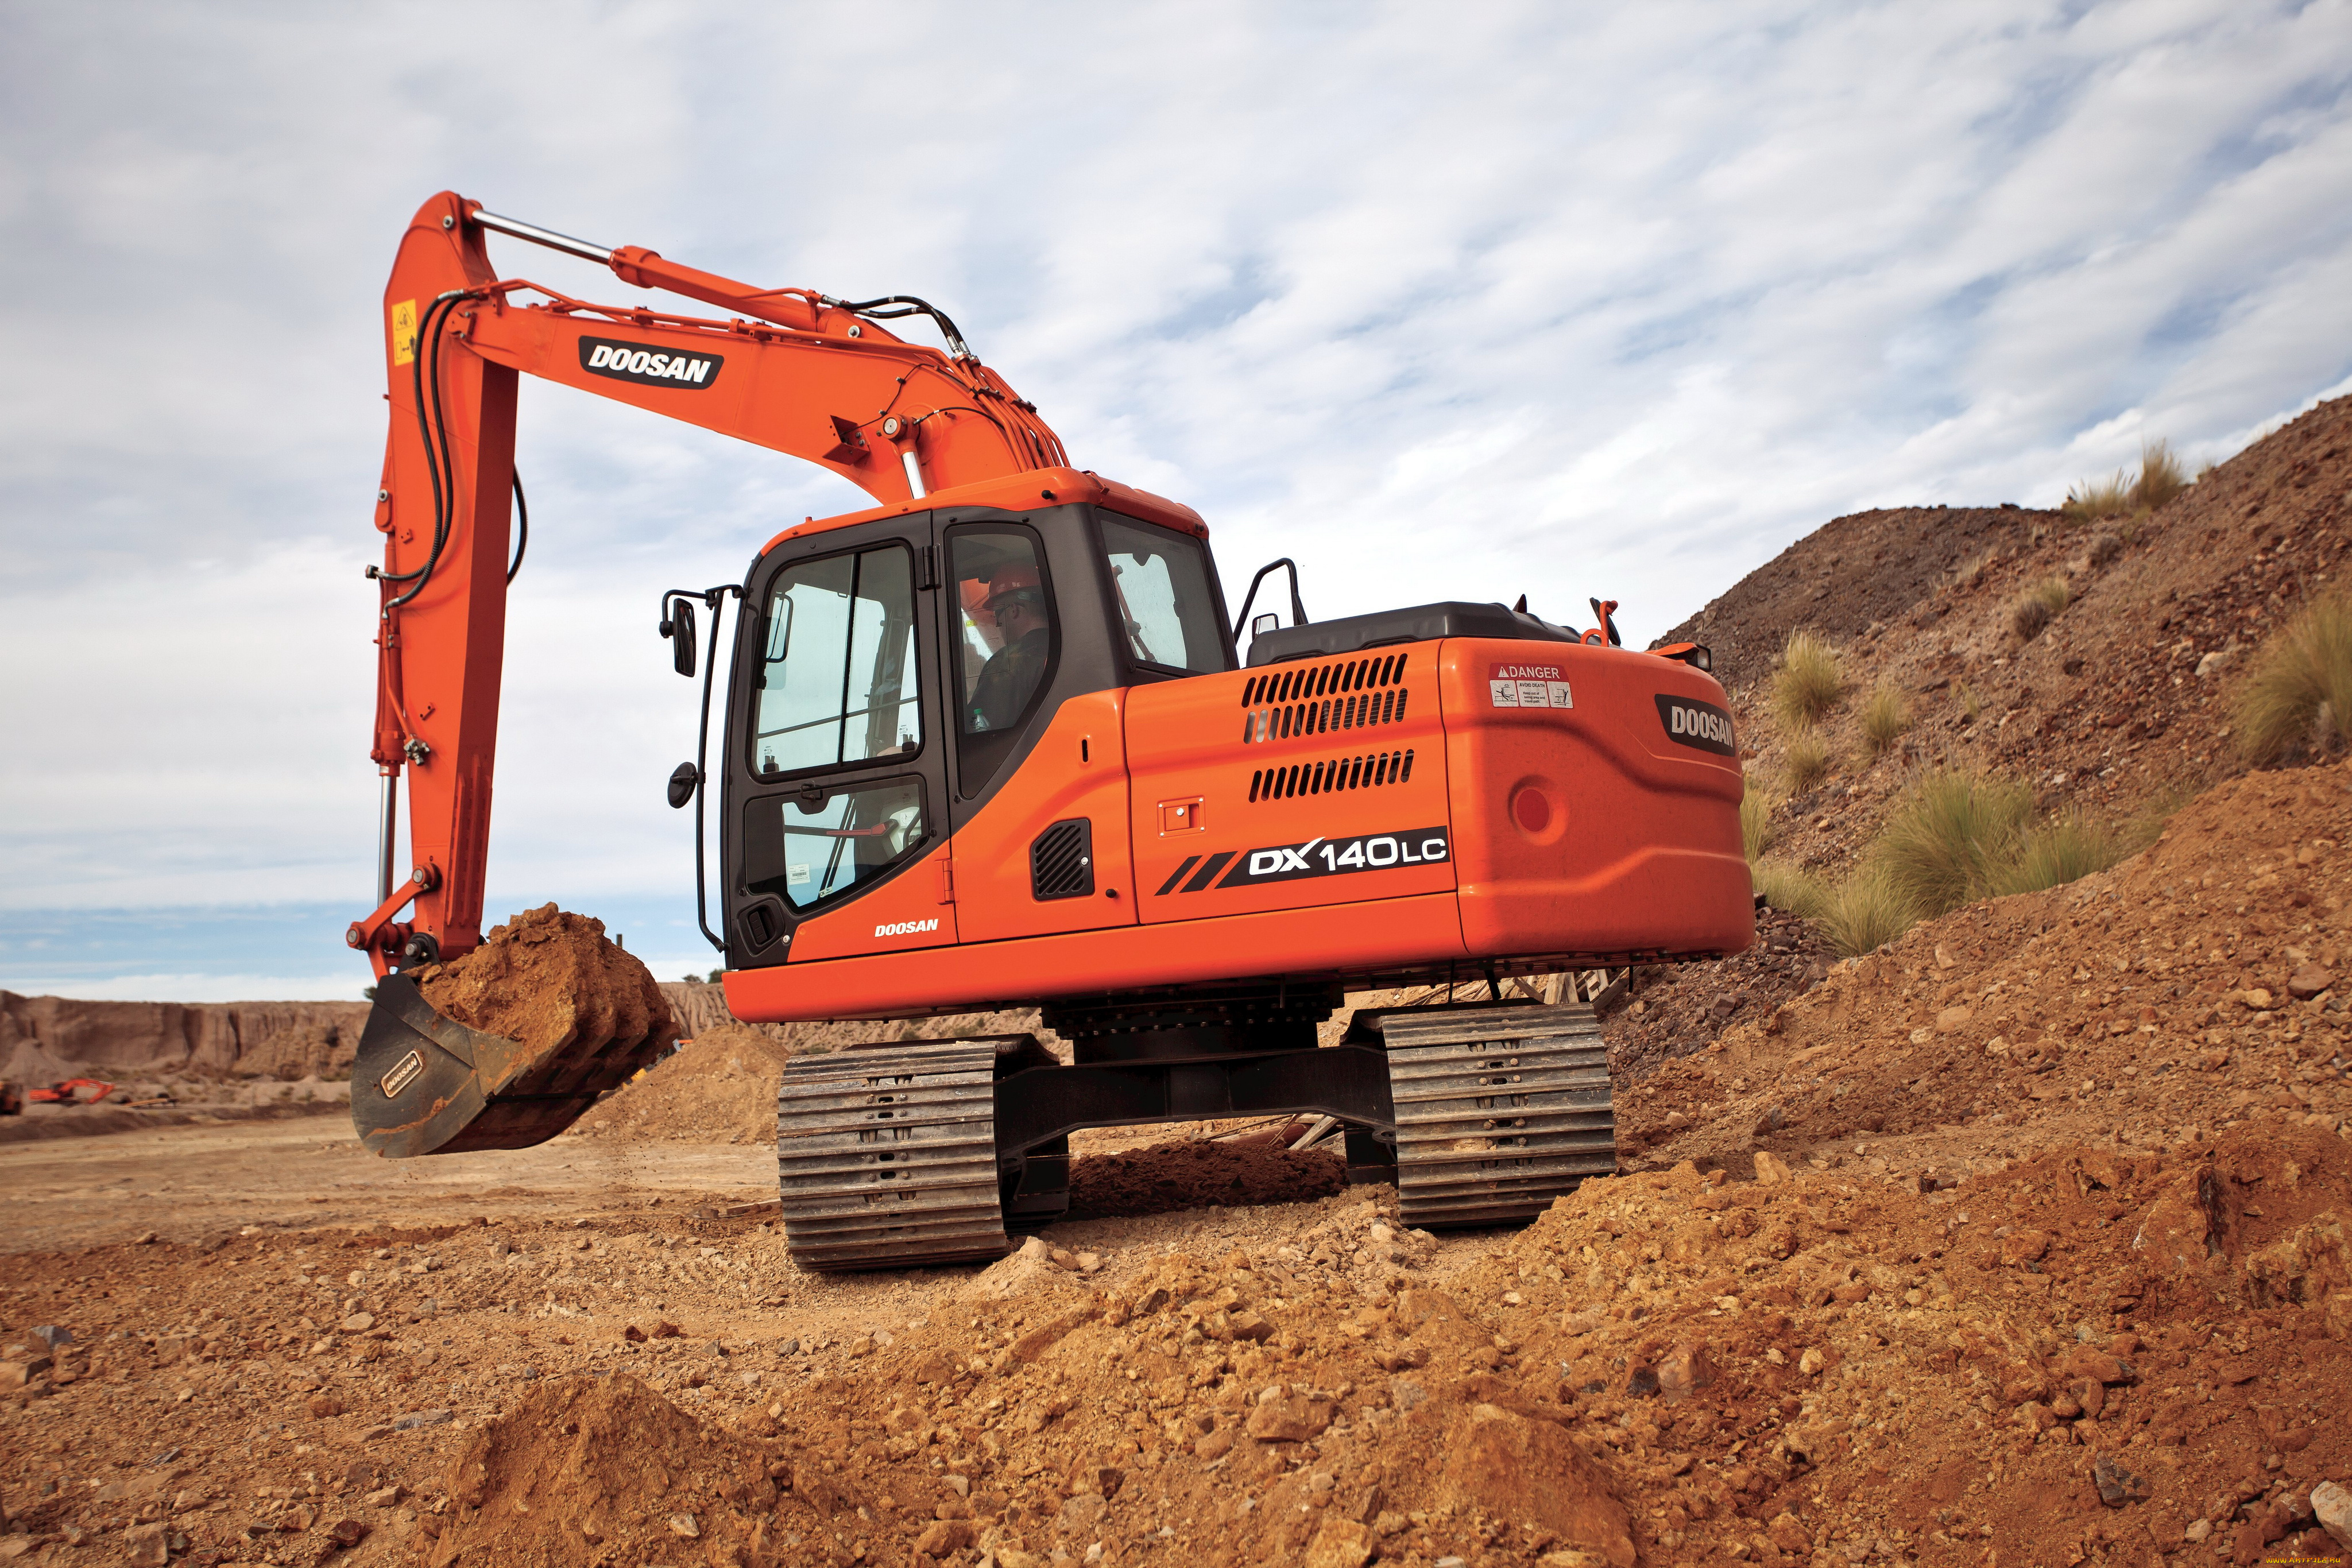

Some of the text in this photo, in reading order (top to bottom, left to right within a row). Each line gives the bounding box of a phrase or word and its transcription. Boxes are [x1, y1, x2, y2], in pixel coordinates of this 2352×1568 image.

[588, 344, 711, 383] DOOSAN
[1508, 666, 1560, 679] DANGER
[1672, 706, 1733, 748] DOOSAN
[875, 919, 938, 937] DOOSAN
[387, 1057, 417, 1091] DOOSAN
